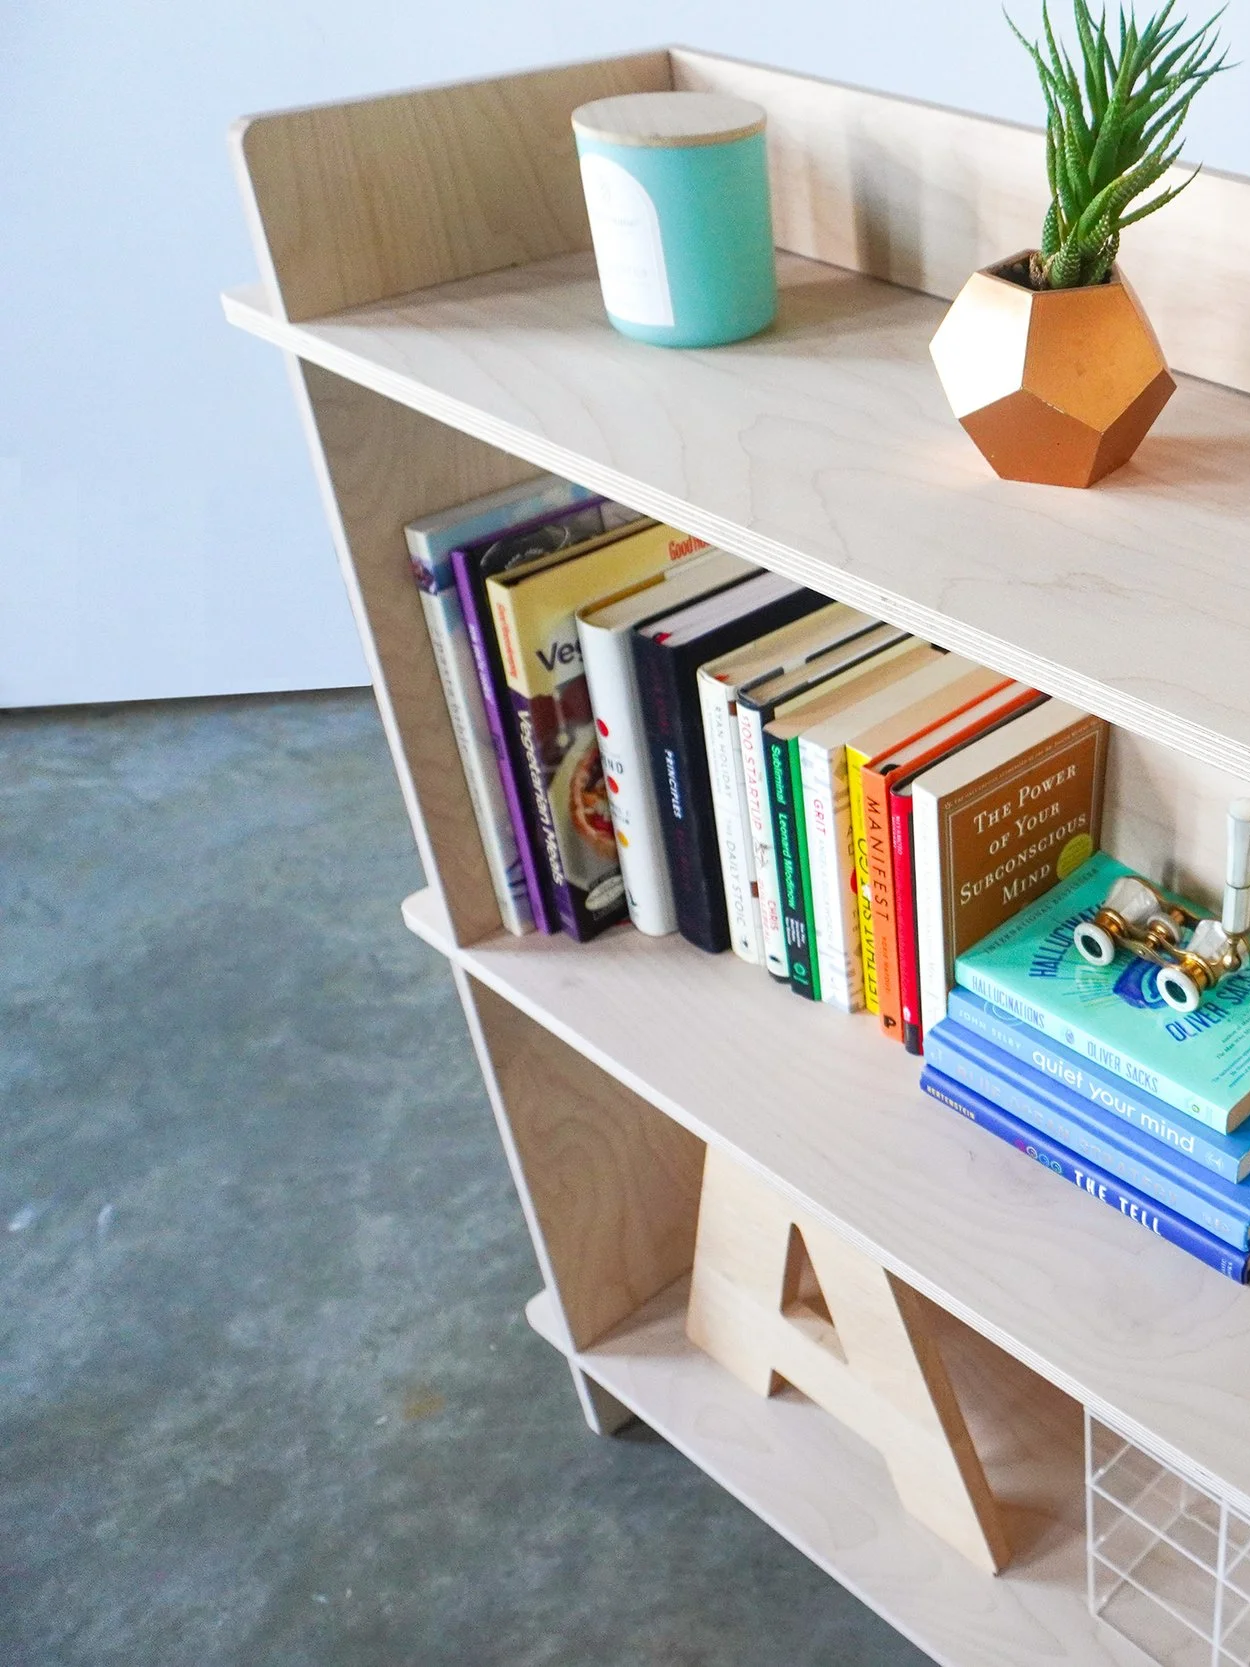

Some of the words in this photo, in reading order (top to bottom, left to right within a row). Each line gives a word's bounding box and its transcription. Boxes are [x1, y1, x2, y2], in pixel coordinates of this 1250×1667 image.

[517, 710, 552, 826] Vegetarian
[543, 827, 565, 886] Meals
[664, 749, 683, 820] PRINCIPLES
[720, 743, 732, 799] HOLIDAY
[747, 756, 763, 831] STARTUP
[771, 743, 786, 805] Subliminal
[973, 803, 1012, 834] THE
[1017, 764, 1078, 809] POWER
[779, 812, 793, 858] Leonard
[813, 798, 826, 836] GRIT
[989, 832, 1011, 856] OF
[1015, 801, 1061, 839] YOUR
[726, 839, 740, 880] DAILY
[783, 859, 797, 910] Mlodinow
[866, 795, 890, 921] MANIFEST
[959, 812, 1087, 906] SUBCONSCIOUS
[1002, 864, 1051, 906] MIND
[732, 884, 747, 927] STOIC
[767, 900, 780, 931] CHRIS
[971, 975, 1045, 1029] HALLUCINATIONS
[1087, 1041, 1121, 1074] OLIVER
[1125, 1062, 1159, 1094] SACKS
[1165, 1001, 1230, 1042] OLIVER
[958, 1008, 986, 1031] JOHN
[991, 1027, 1022, 1050] SELBY
[1032, 1050, 1085, 1089] quiet
[1089, 1082, 1137, 1118] your
[1140, 1112, 1195, 1153] mind
[1074, 1169, 1107, 1202] THE
[1119, 1196, 1162, 1236] TELL
